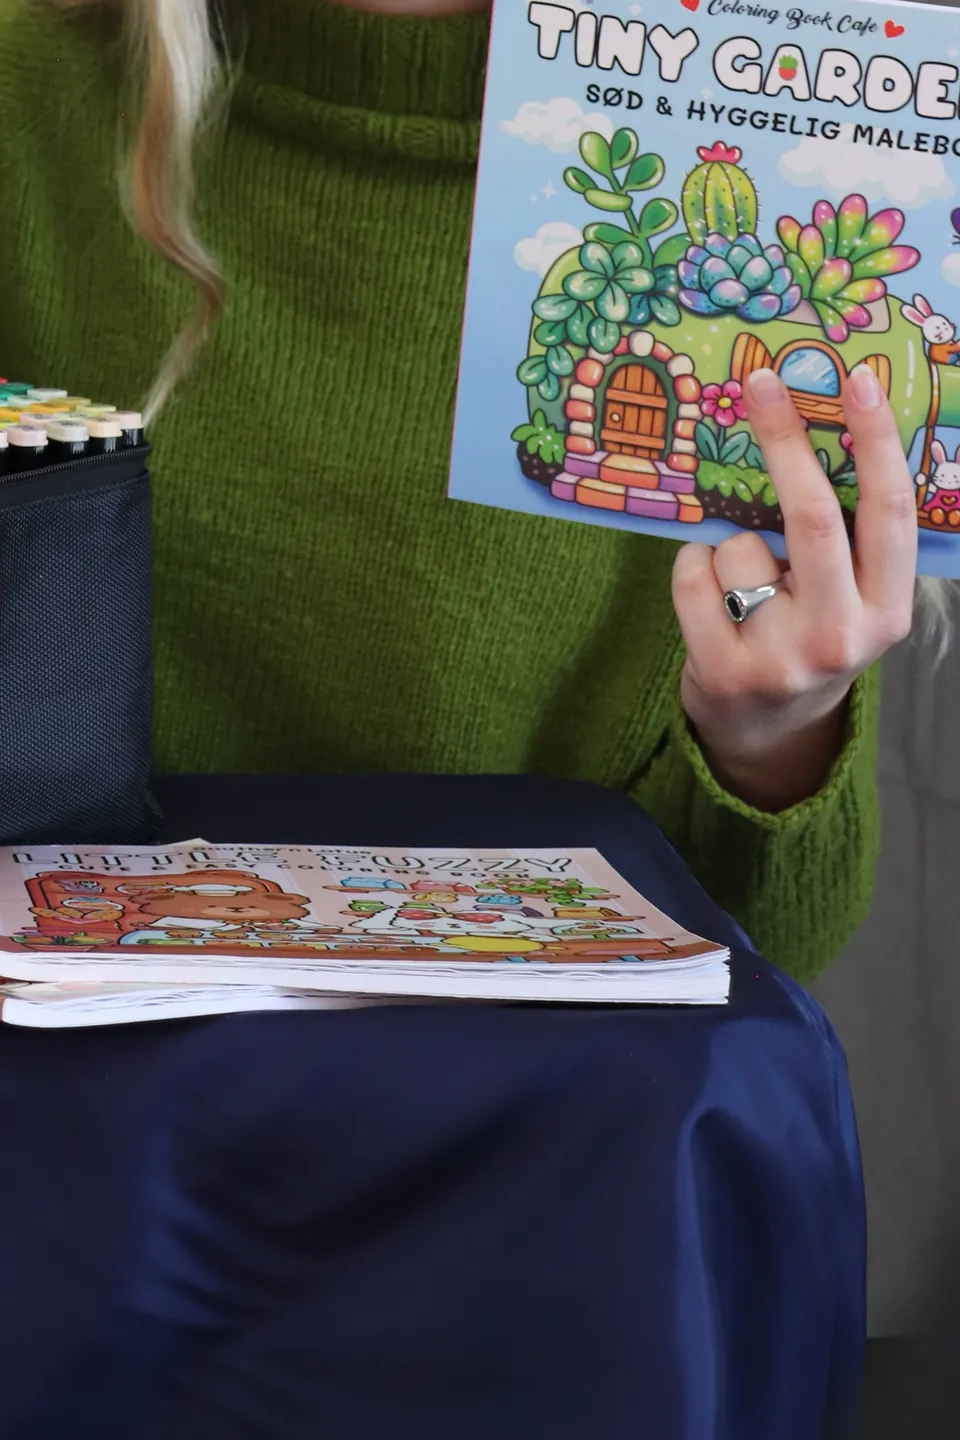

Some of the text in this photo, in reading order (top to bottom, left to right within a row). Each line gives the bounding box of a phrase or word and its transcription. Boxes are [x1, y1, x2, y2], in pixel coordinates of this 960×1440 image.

[786, 8, 833, 30] Book
[836, 15, 879, 37] Cafe
[527, 0, 960, 120] TINY GARDE
[585, 83, 644, 110] SØD
[656, 96, 673, 116] &
[686, 100, 841, 140] HYGGELIG
[12, 850, 573, 873] LITTLE FUZZY
[58, 864, 131, 872] CUTE
[276, 863, 431, 876] COLORING
